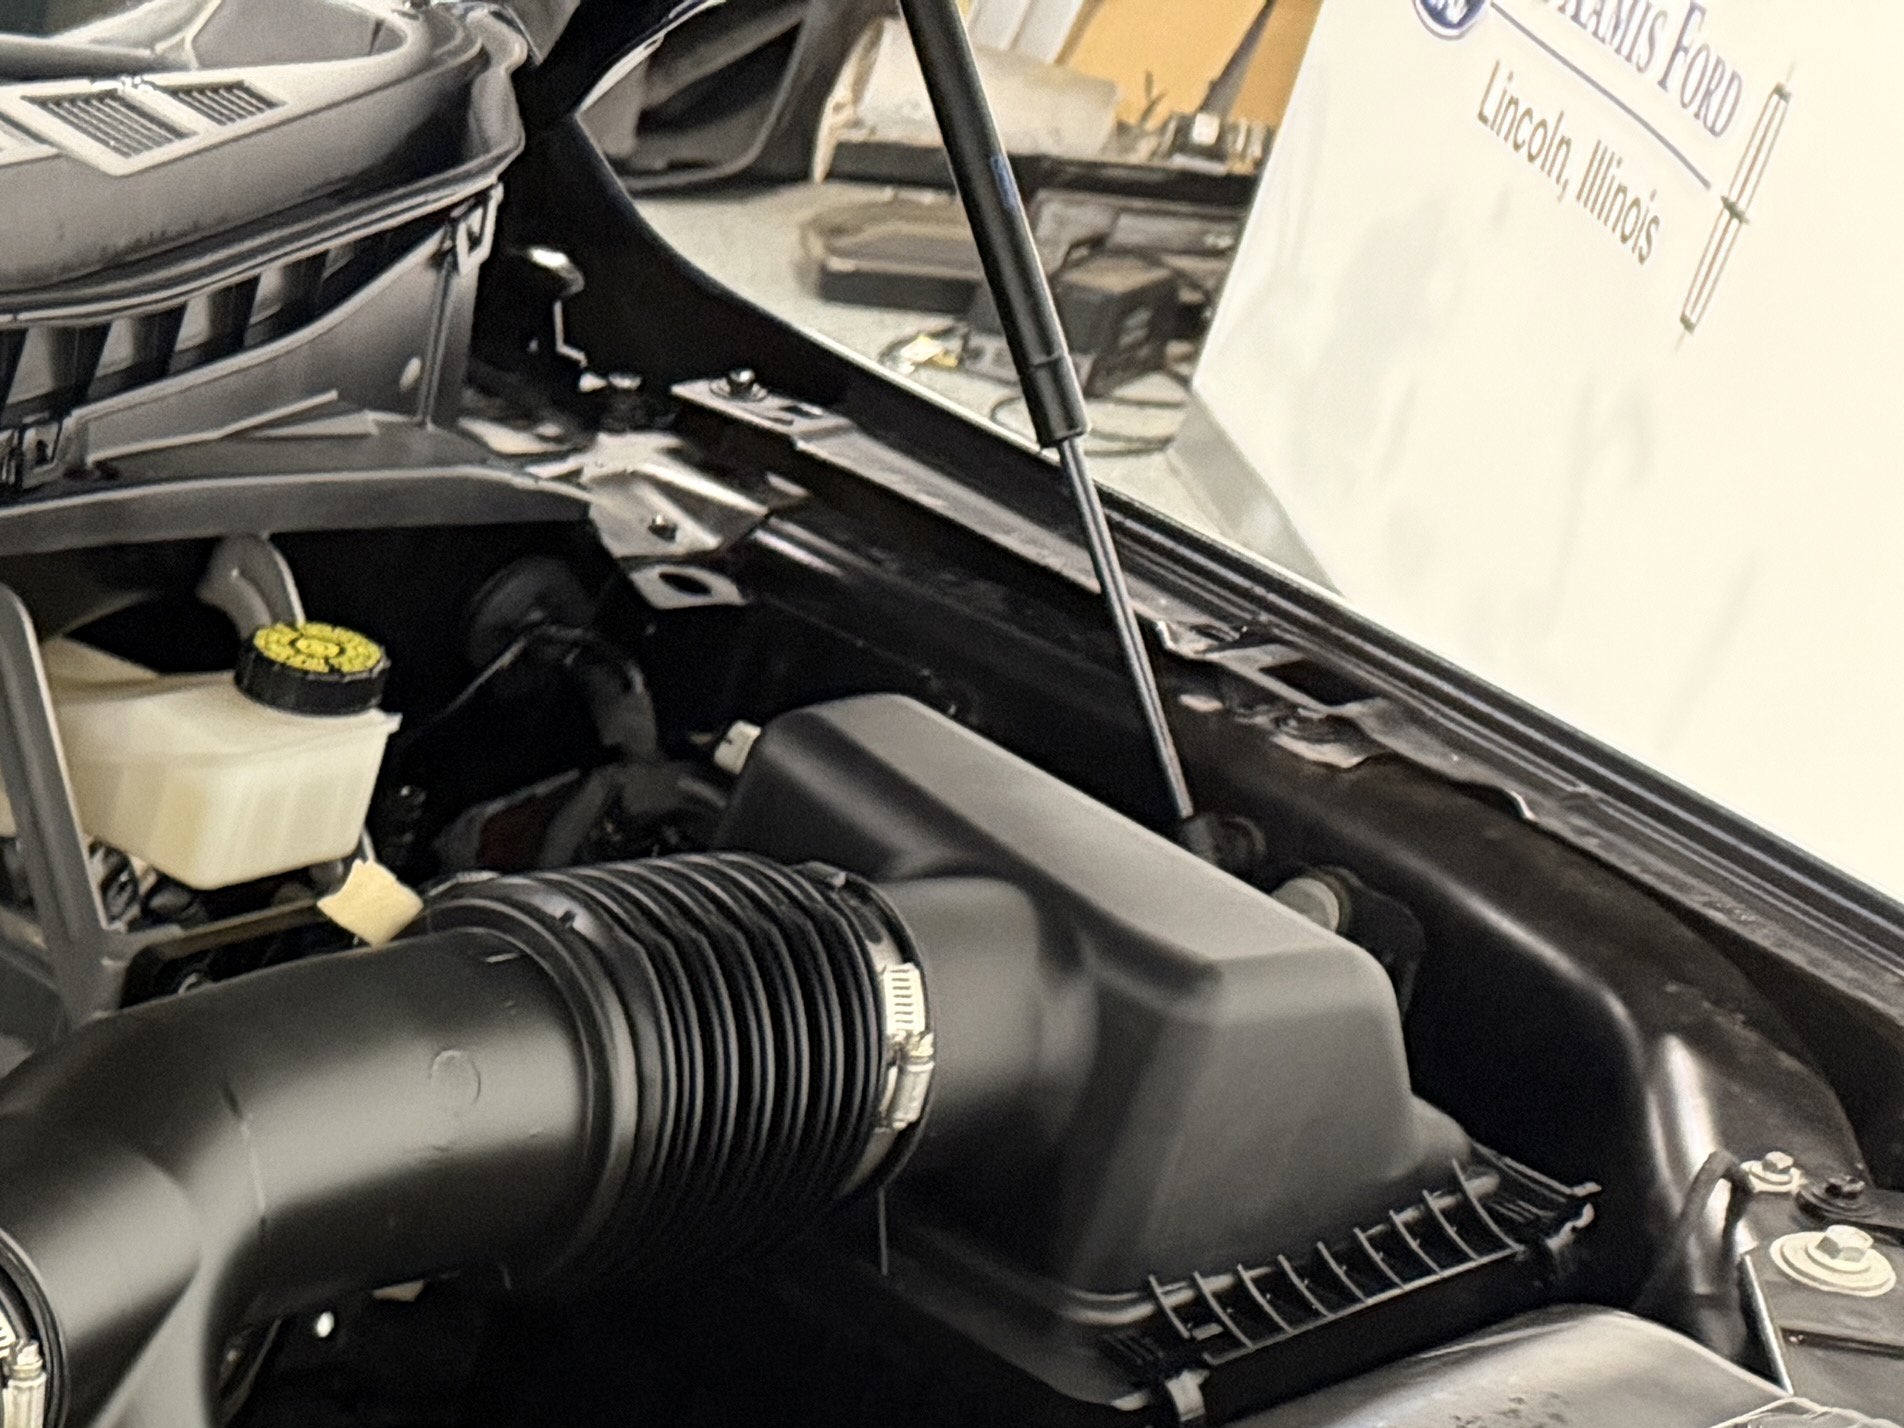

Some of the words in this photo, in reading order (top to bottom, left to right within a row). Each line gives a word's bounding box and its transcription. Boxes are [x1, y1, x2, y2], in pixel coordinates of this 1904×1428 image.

[1657, 3, 1742, 138] FORD
[1477, 58, 1573, 203] Lincoln,
[1576, 138, 1660, 266] Illinois
